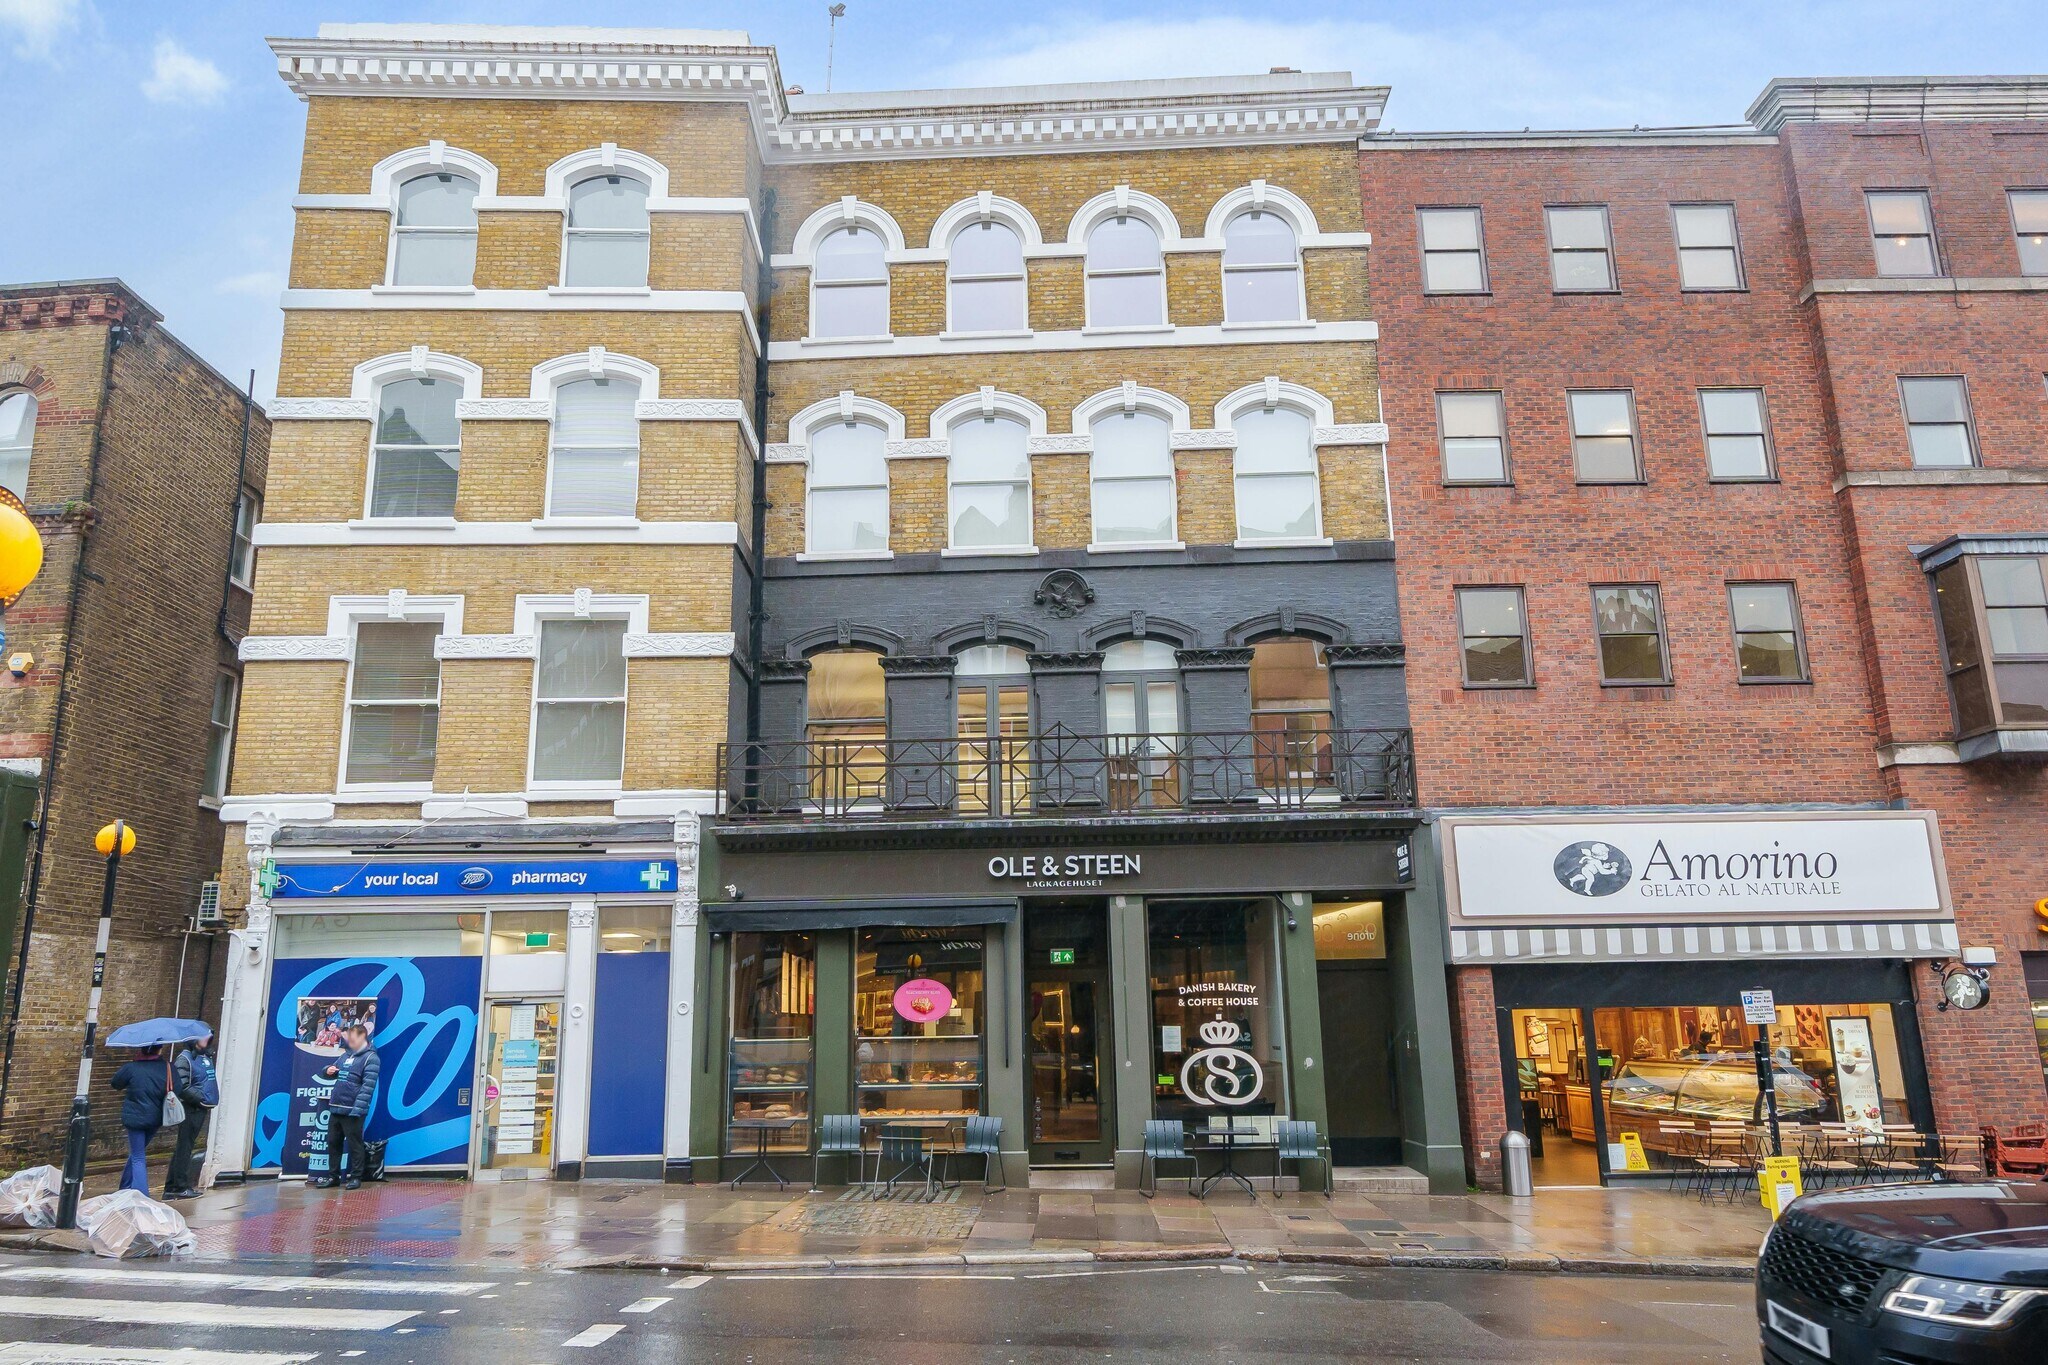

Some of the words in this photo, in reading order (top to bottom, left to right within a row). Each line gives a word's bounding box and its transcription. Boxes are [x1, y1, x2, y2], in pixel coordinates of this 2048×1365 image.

[988, 856, 1036, 877] OLE
[1042, 855, 1059, 876] &
[1065, 854, 1141, 876] STEEN
[1640, 839, 1838, 881] Amorino
[364, 875, 399, 889] your
[402, 872, 439, 886] local
[512, 870, 588, 886] pharmacy
[1026, 879, 1103, 888] LAGKAGEHUSET
[1640, 883, 1711, 897] GELATO
[1718, 883, 1741, 896] AL
[1746, 881, 1842, 896] NATURALE
[1178, 983, 1215, 994] DANISH
[1218, 983, 1256, 993] BAKERY
[1178, 998, 1185, 1006] &
[1187, 998, 1224, 1006] COFFEE
[1226, 997, 1259, 1006] HOUSE
[296, 1087, 334, 1097] FIGHT
